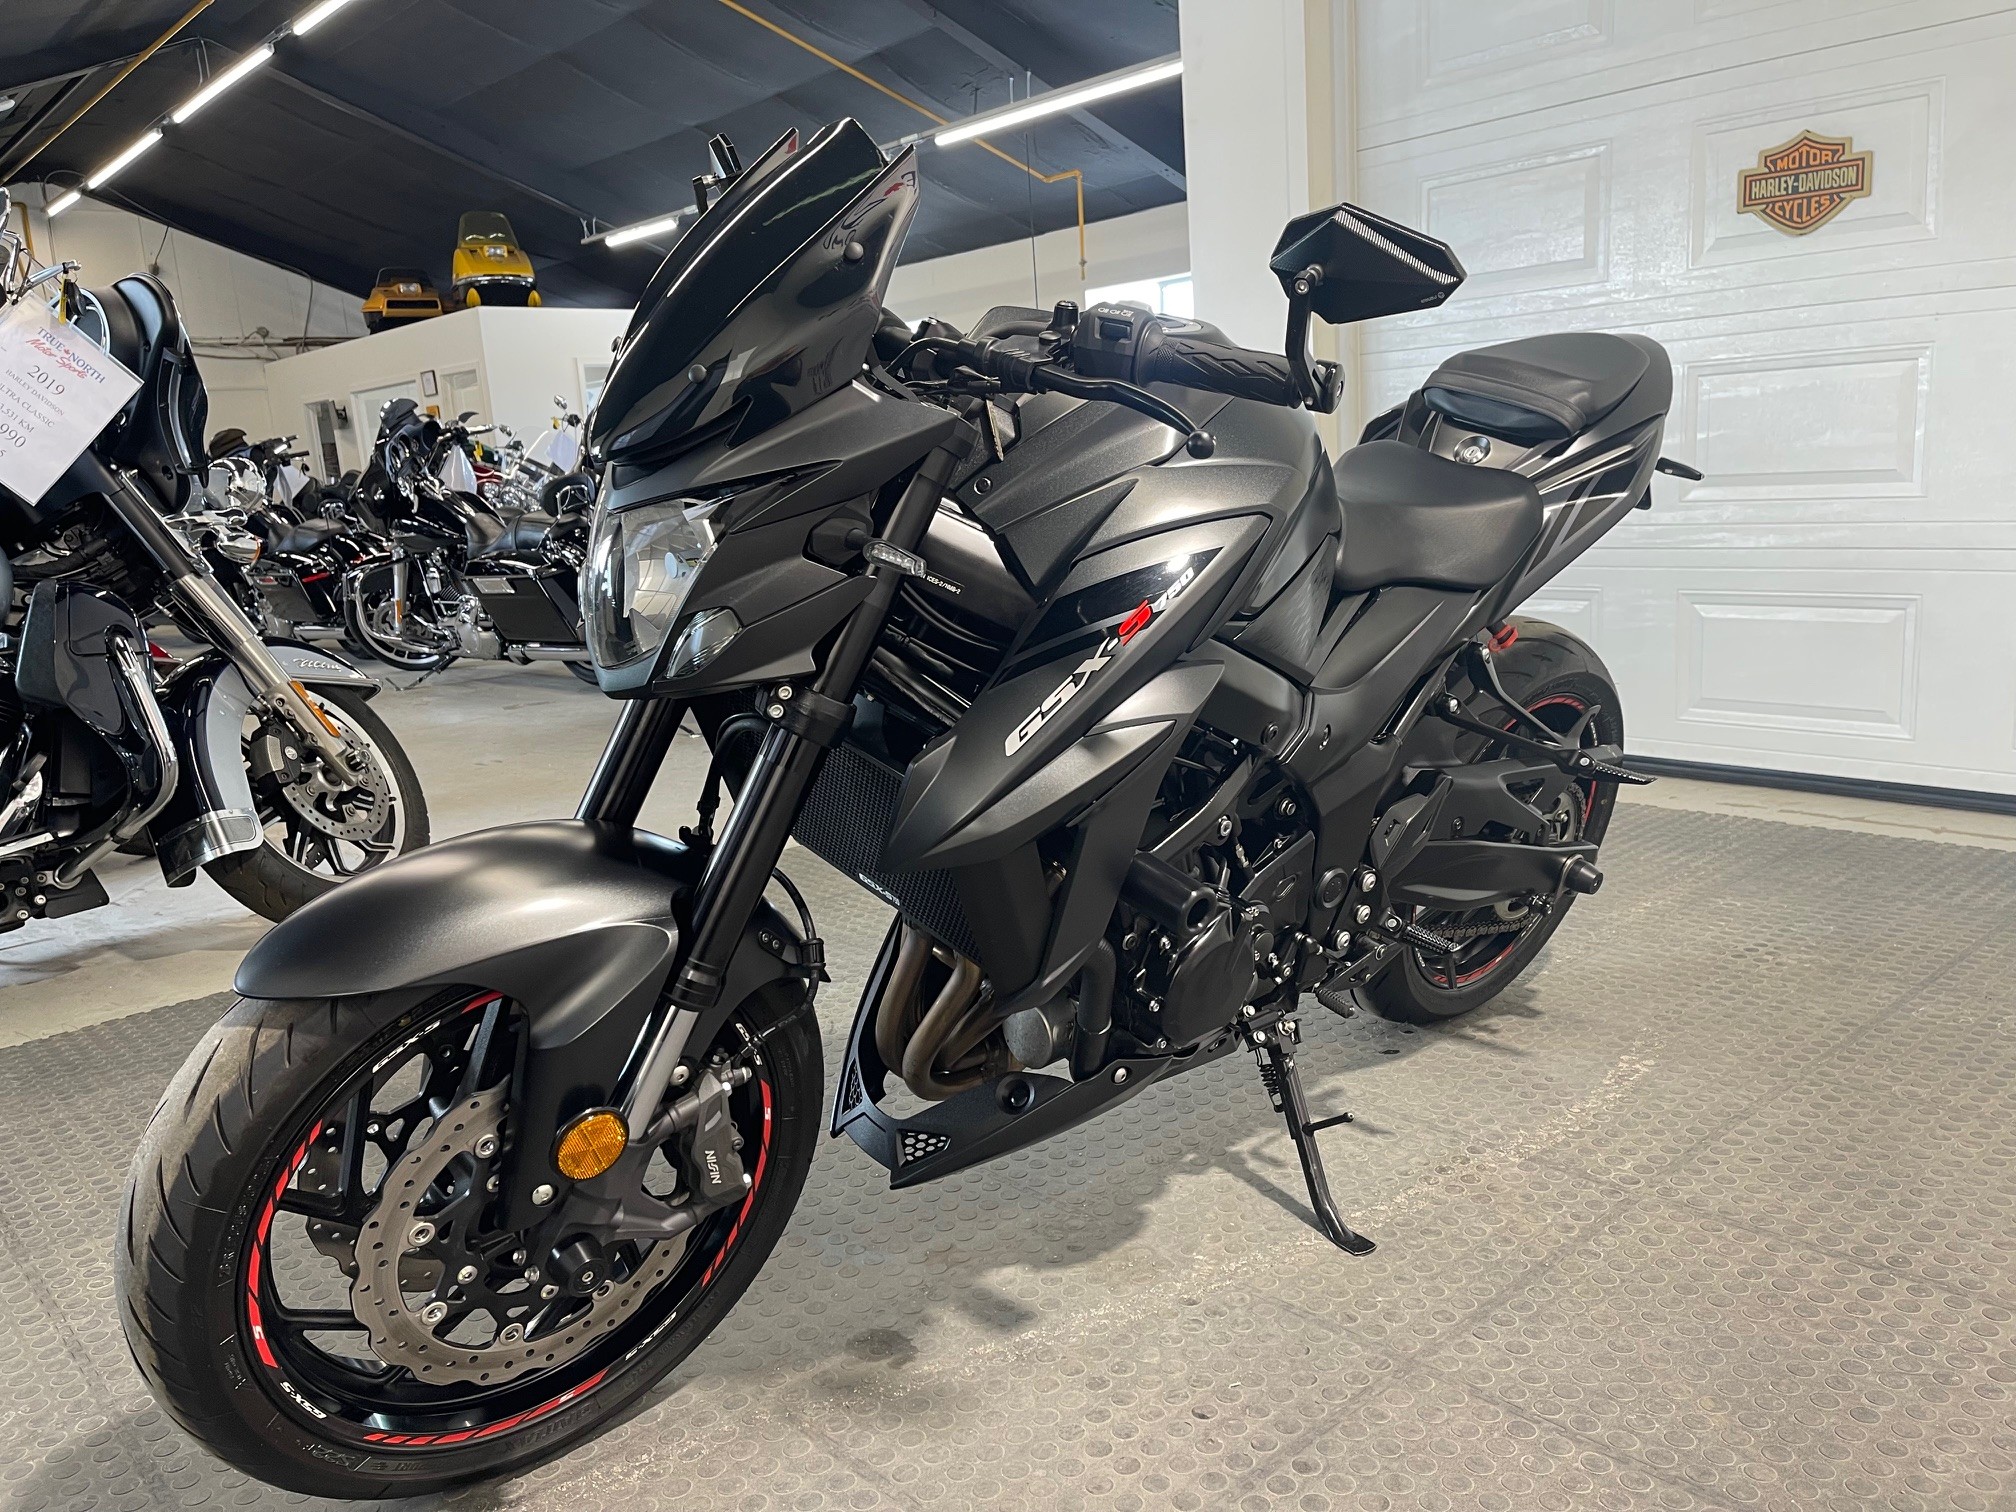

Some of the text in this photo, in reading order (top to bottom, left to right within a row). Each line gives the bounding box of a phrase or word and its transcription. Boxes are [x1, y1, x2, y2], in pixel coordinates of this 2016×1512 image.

[1776, 144, 1834, 172] MOTOR
[1751, 166, 1857, 200] HARLEY-DAVIDSON
[1774, 195, 1831, 223] CYCLES
[25, 338, 88, 379] Motor Sports
[37, 326, 106, 384] TRUE NORTH
[5, 369, 65, 416] HARLEY DAVIDSON
[27, 365, 66, 396] 2019
[0, 383, 56, 428] LTRA CLASSIC
[18, 418, 35, 433] KM
[704, 1150, 722, 1184] NISSIN
[279, 1381, 328, 1419] GSX-S
